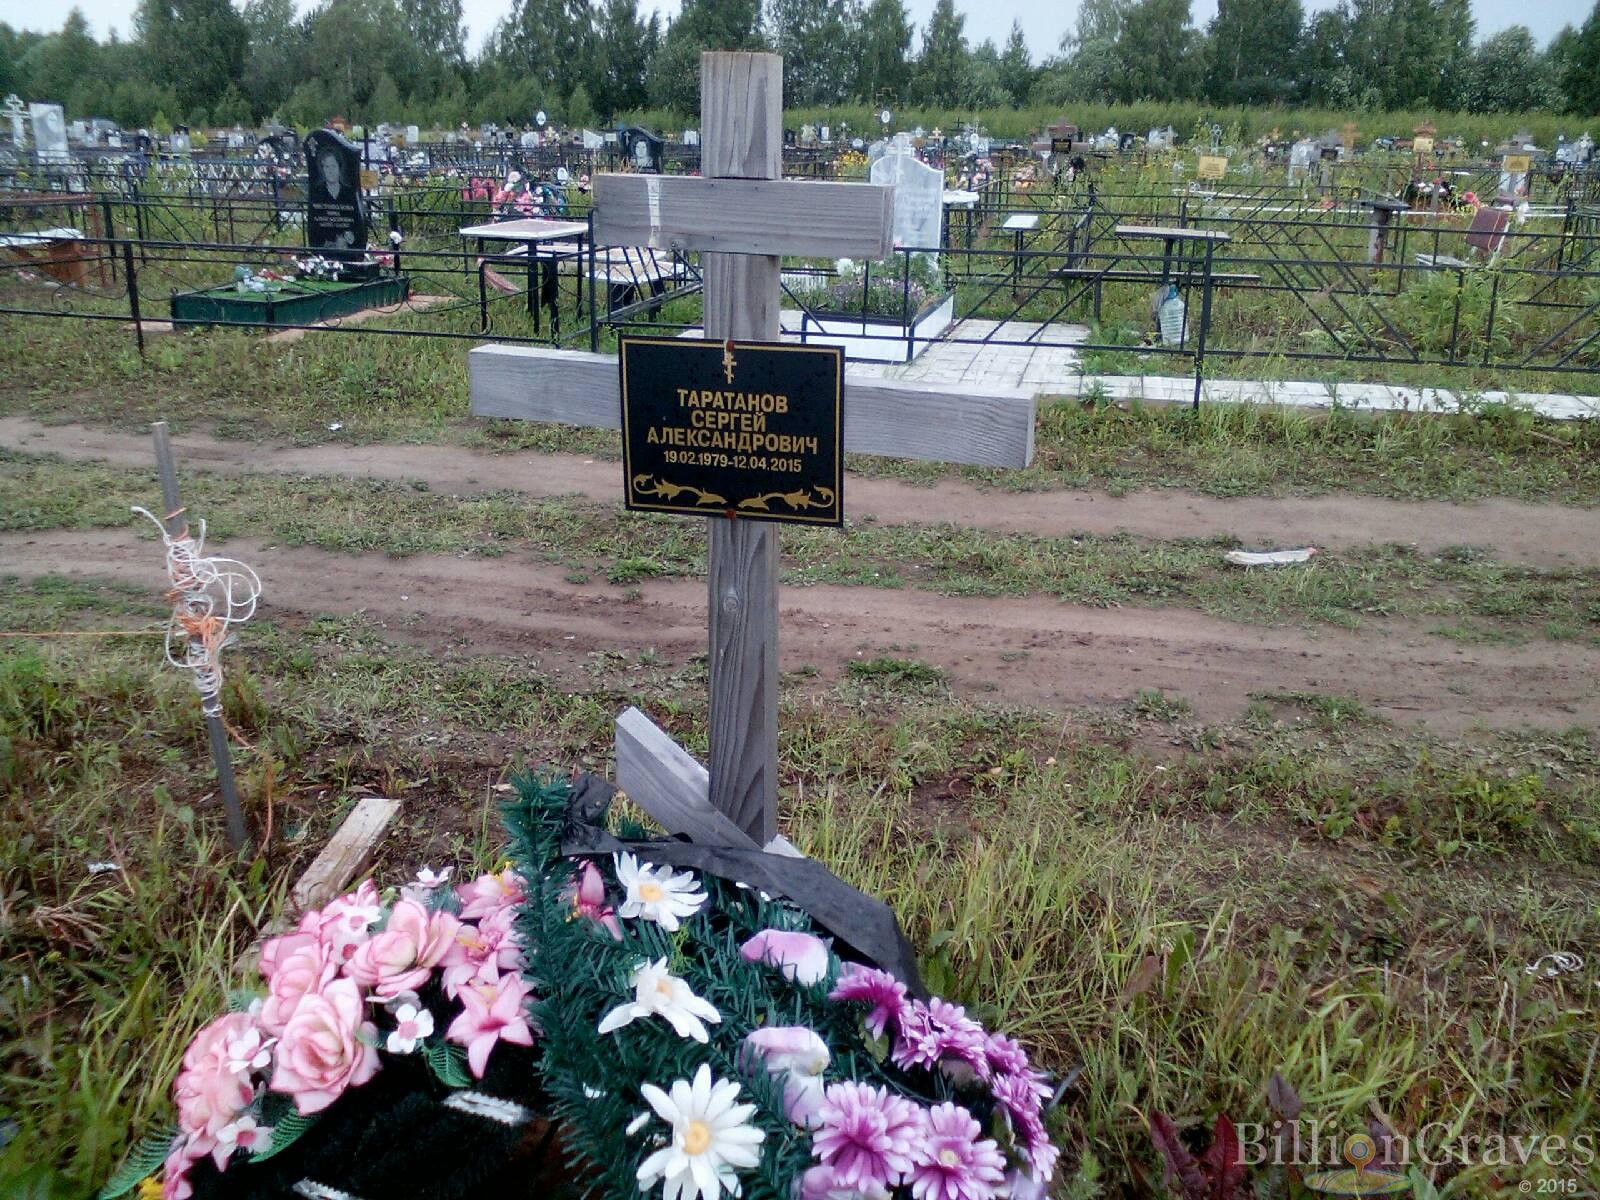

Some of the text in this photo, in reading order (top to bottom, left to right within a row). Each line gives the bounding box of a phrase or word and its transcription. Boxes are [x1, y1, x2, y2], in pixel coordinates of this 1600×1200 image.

[677, 389, 788, 413] ТАРАТАНОВ
[691, 410, 766, 432] СЕРГЕЙ
[647, 427, 817, 454] АЛЕКСАНДРОВИЧ
